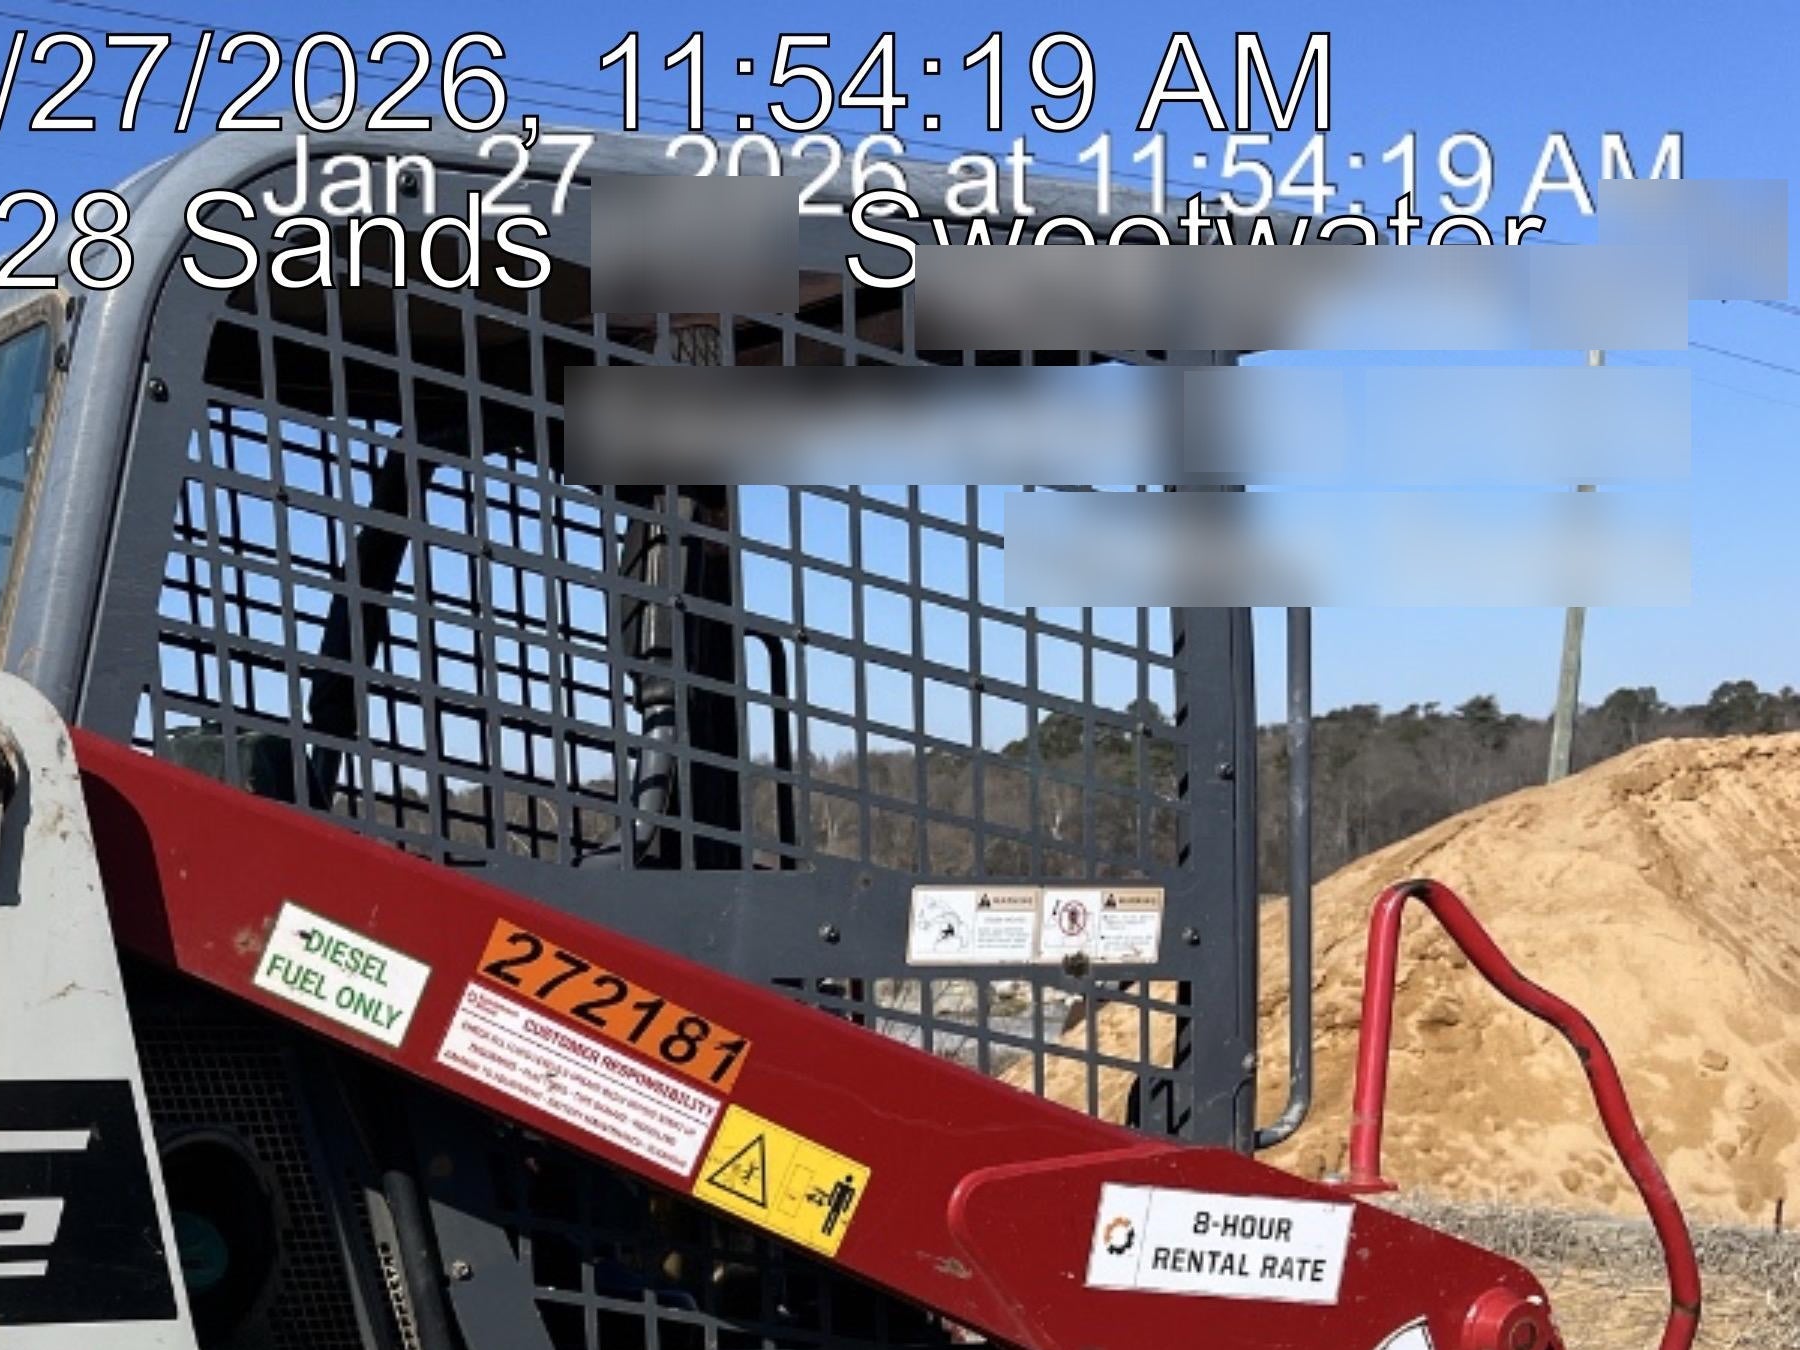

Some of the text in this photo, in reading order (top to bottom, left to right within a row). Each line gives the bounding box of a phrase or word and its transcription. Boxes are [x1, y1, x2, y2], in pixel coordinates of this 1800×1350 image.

[305, 926, 390, 987] DIESEL
[265, 953, 404, 1033] FUEL ONLY
[482, 931, 749, 1084] 272181
[522, 1018, 602, 1066] CUSTOMER
[601, 1049, 715, 1117] RESPONSIBILITY
[1192, 1210, 1294, 1243] 8-HOUR
[1151, 1246, 1327, 1283] RENTAL RATE
